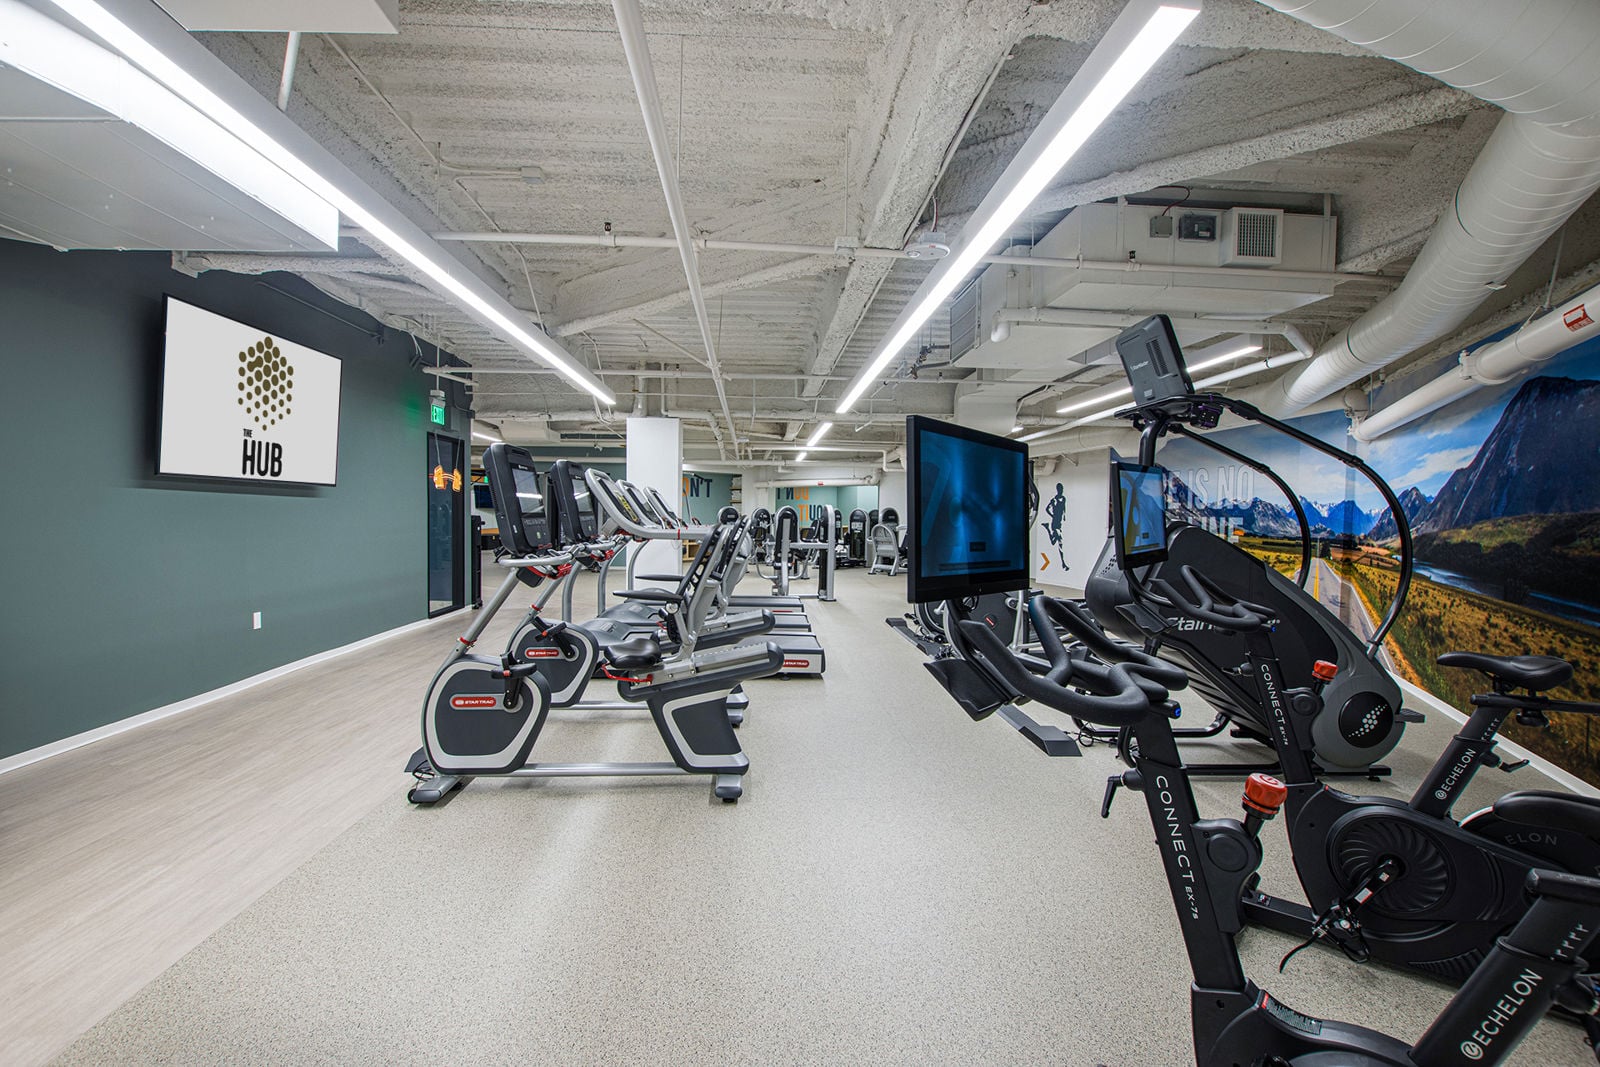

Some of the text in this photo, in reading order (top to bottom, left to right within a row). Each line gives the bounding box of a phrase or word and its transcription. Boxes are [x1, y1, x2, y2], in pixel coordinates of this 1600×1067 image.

[243, 428, 253, 438] THE
[242, 438, 283, 477] HUB
[1188, 467, 1209, 510] IS
[1217, 465, 1254, 510] NO
[1260, 663, 1286, 726] CONNECT
[1441, 748, 1477, 792] ECHELON
[1156, 775, 1195, 883] CONNECT
[1504, 832, 1559, 846] ELON
[1472, 967, 1543, 1047] ECHELON
